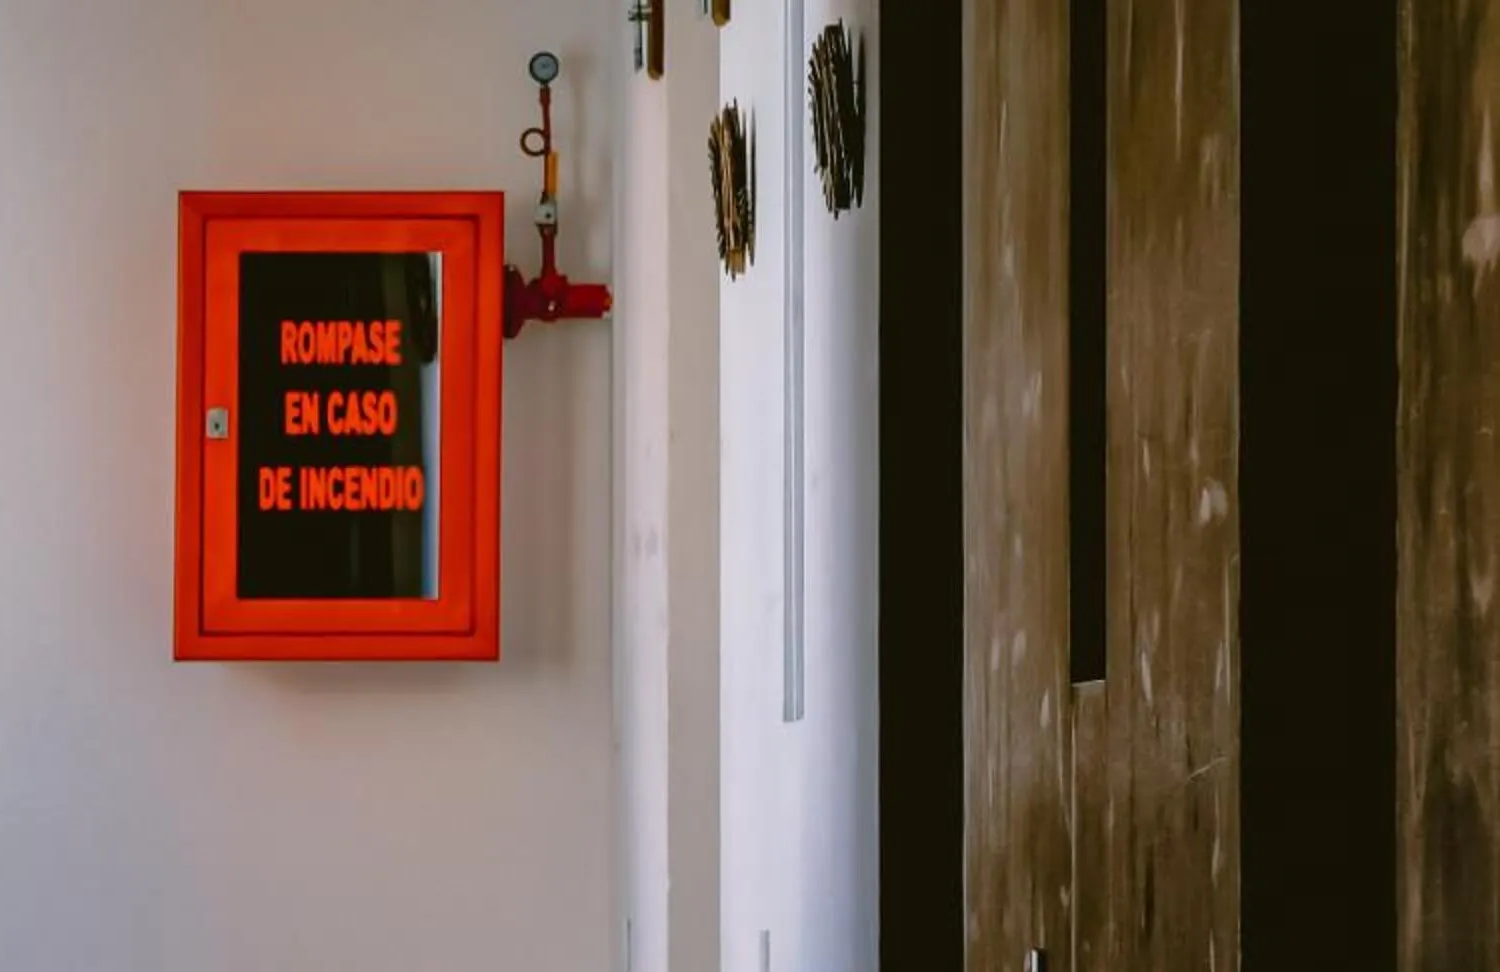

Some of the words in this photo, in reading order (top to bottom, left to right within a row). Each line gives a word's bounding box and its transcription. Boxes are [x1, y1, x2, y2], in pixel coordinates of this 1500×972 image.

[280, 319, 402, 365] ROMPASE
[284, 390, 320, 436] EN
[327, 390, 398, 436] CASO
[258, 466, 293, 511] DE
[300, 465, 425, 511] INCENDIO
